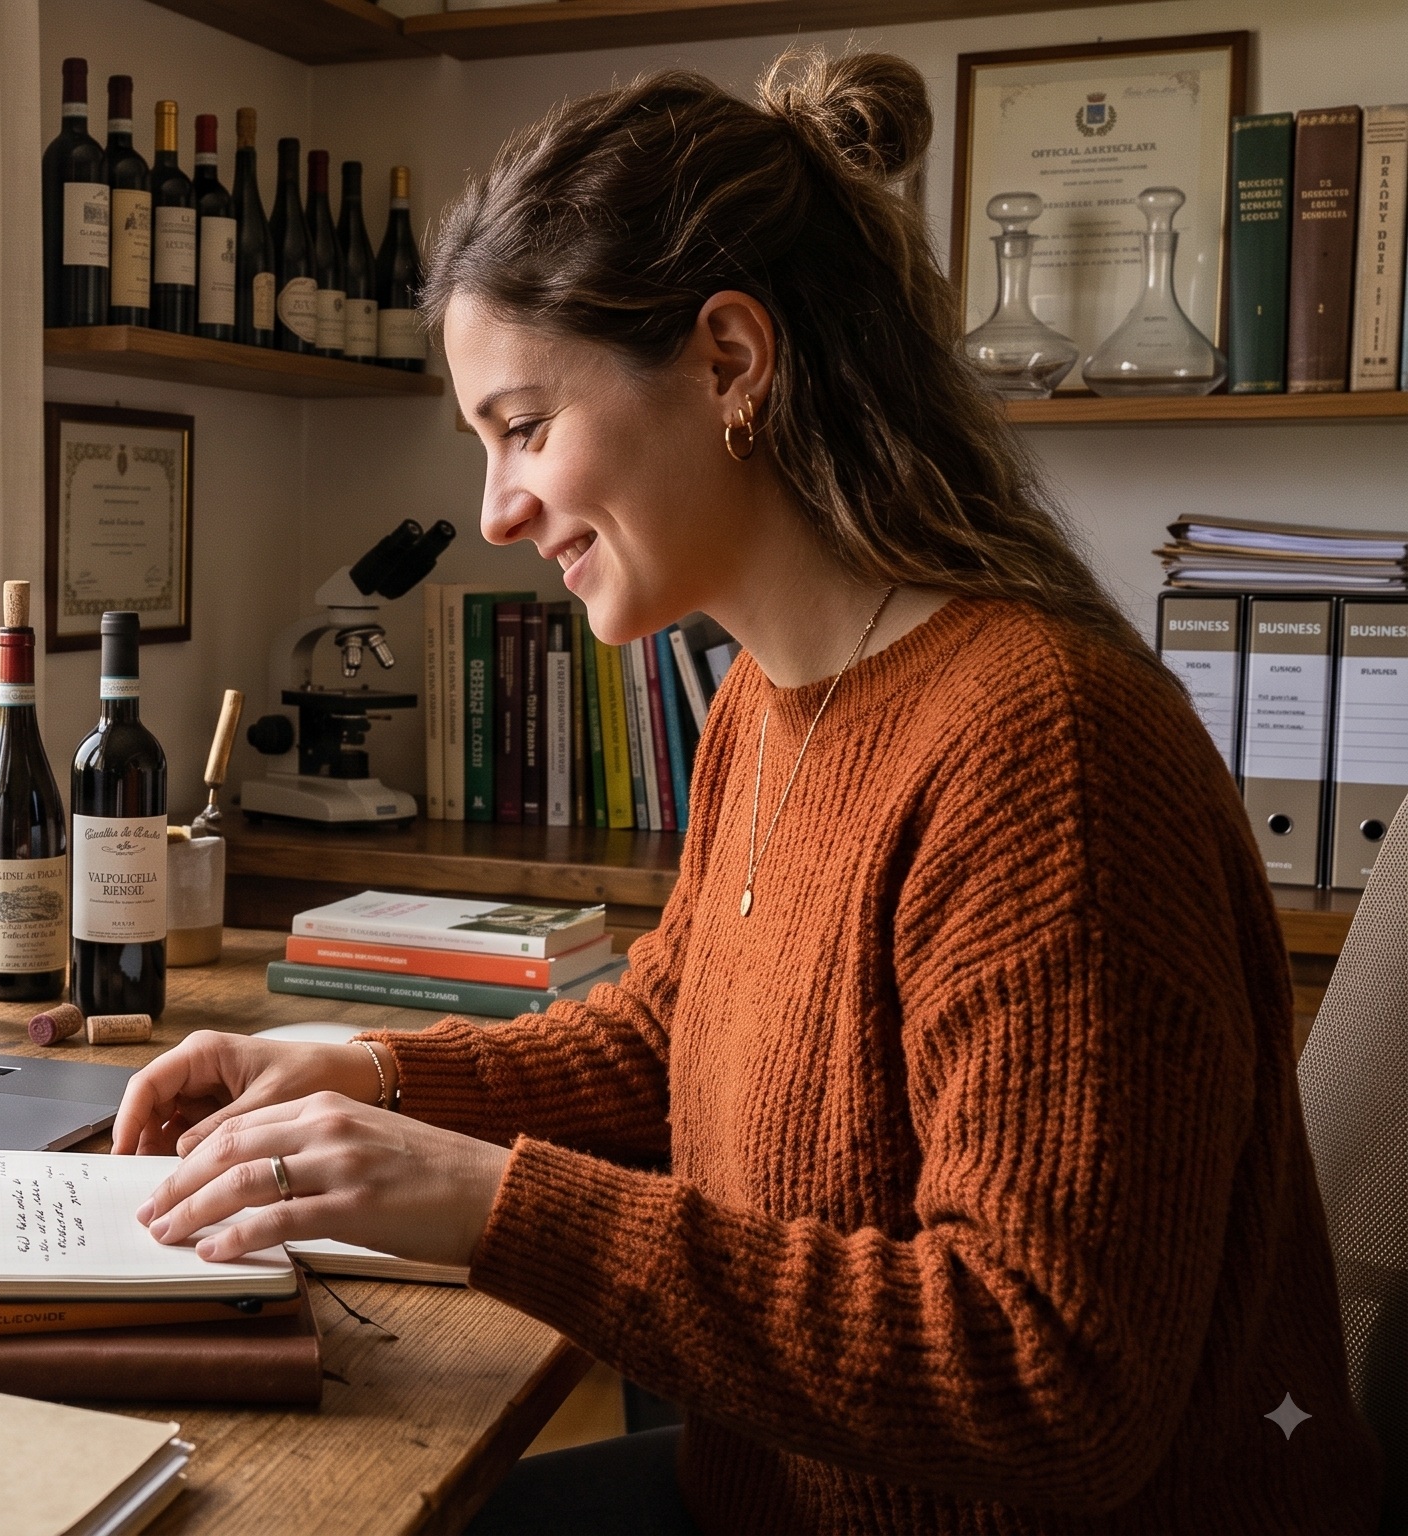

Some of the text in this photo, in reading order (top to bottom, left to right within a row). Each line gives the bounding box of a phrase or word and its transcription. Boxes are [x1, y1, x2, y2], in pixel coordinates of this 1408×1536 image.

[1169, 620, 1230, 632] BUSINESS
[1258, 622, 1321, 635] BUSINESS
[1350, 625, 1408, 637] BUSINES
[88, 872, 158, 884] VALPOLICELLA
